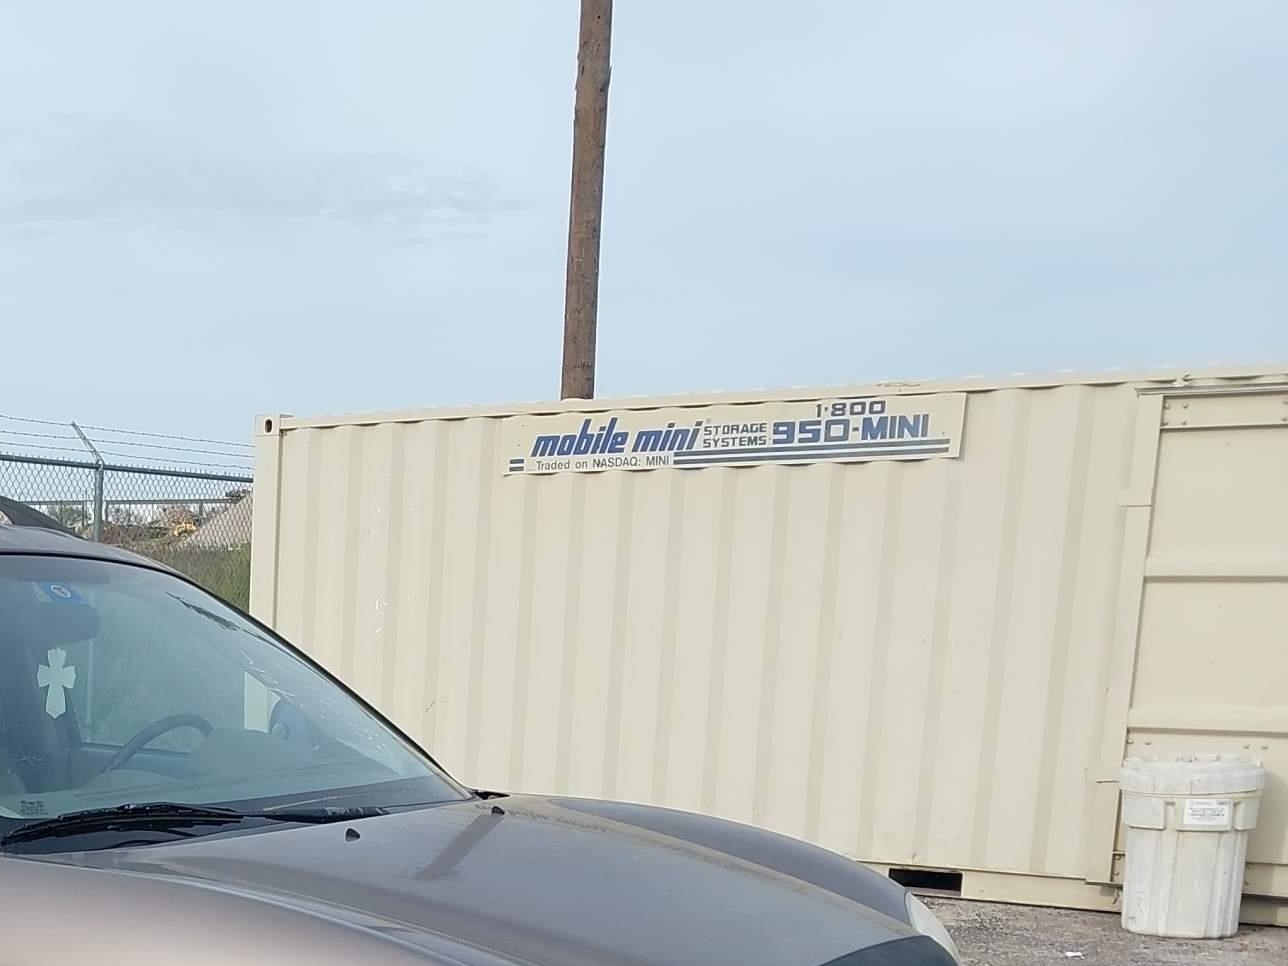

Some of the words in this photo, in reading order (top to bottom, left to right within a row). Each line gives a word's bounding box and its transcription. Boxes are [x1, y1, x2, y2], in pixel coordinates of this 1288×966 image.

[531, 417, 629, 457] mobile
[631, 421, 704, 452] mini
[704, 423, 767, 435] STORAGE
[772, 414, 929, 444] 950-MINI
[702, 435, 767, 448] SYSTEMS
[536, 460, 571, 471] Traded
[575, 461, 588, 469] on
[592, 457, 641, 468] NASDAQ:
[646, 455, 670, 466] MINI
